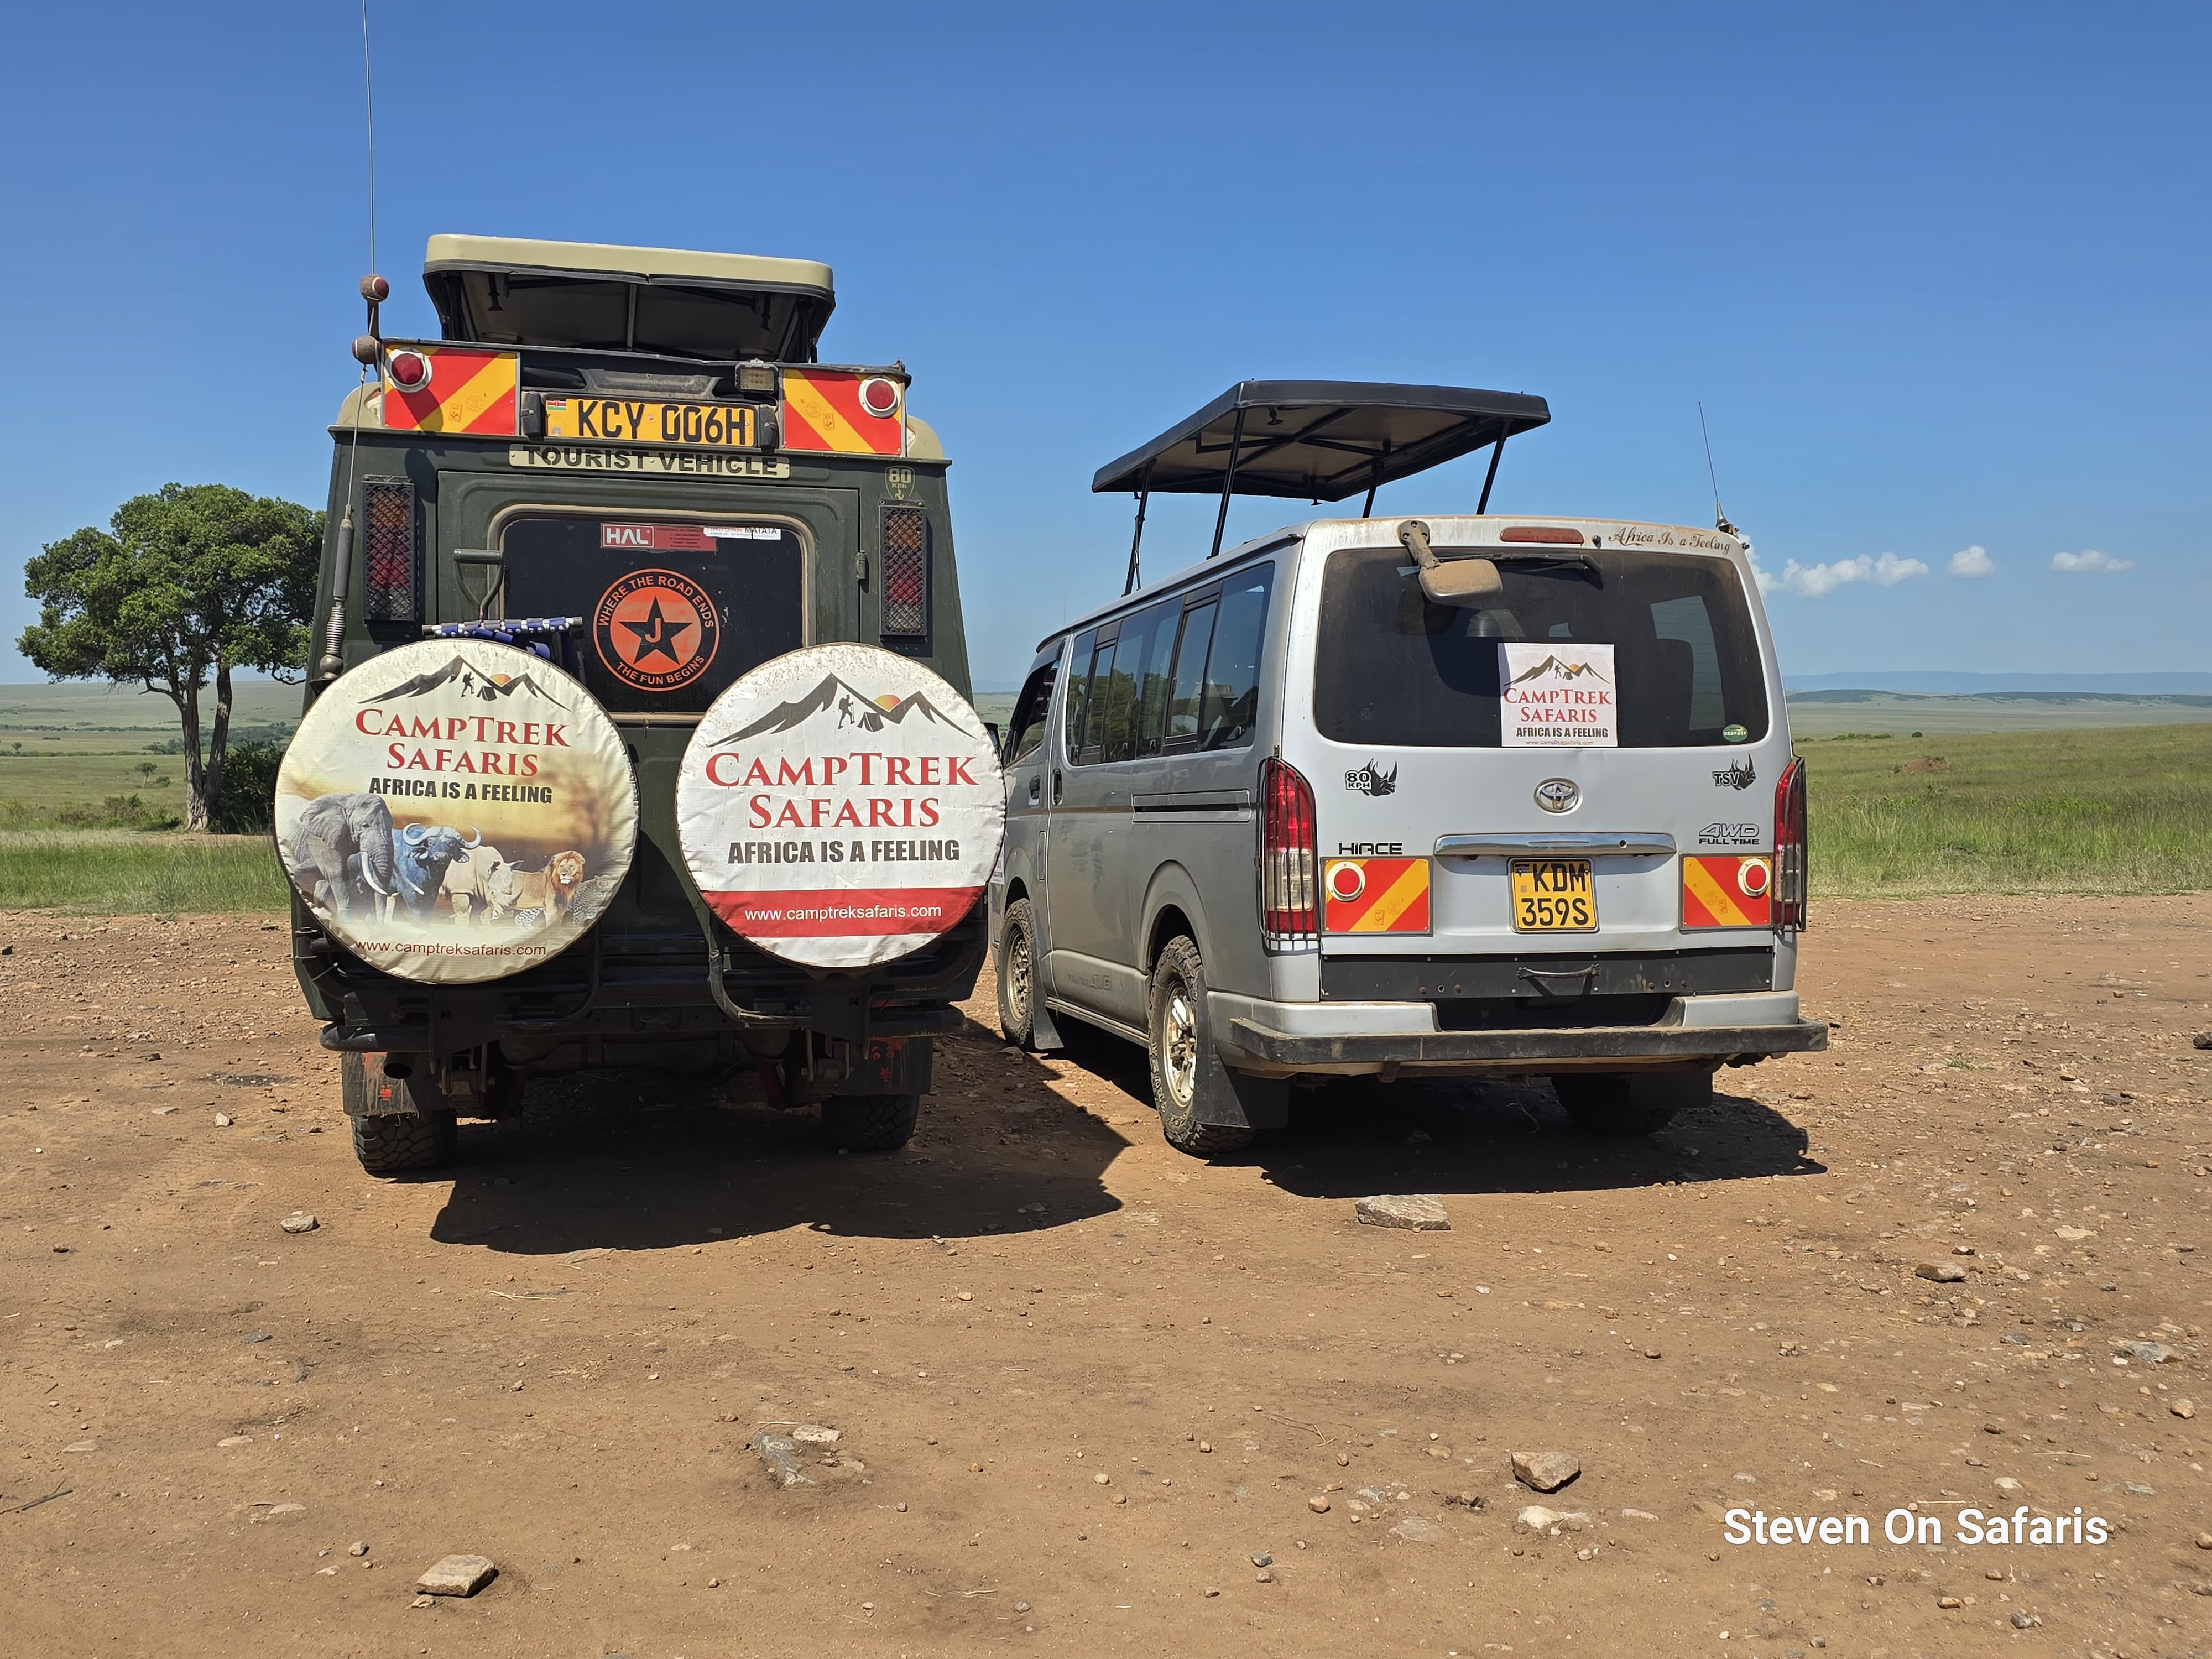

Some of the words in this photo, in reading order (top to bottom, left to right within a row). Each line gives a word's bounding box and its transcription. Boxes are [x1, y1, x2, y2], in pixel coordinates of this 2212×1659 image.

[578, 400, 644, 439] KCY
[662, 405, 746, 445] 006H
[524, 446, 649, 469] TOURIST
[659, 452, 778, 475] VEHICLE
[889, 468, 912, 483] 80
[606, 528, 649, 545] HAL
[1608, 526, 1655, 546] Africa
[1658, 531, 1673, 545] Is
[1689, 533, 1731, 555] Feeling
[598, 585, 629, 627] WHERE
[628, 575, 655, 590] THE
[658, 575, 694, 597] ROAD
[692, 596, 714, 629] ENDS
[645, 618, 661, 643] J
[616, 661, 639, 681] THE
[639, 675, 664, 685] FUN
[666, 655, 705, 685] BEGINS
[1516, 727, 1549, 737] AFRICA
[1552, 727, 1562, 737] IS
[1564, 727, 1571, 737] A
[1573, 728, 1608, 738] FEELING
[368, 776, 437, 797] AFRICA
[442, 780, 460, 799] IS
[463, 782, 481, 799] A
[482, 783, 552, 803] FEELING
[1347, 772, 1370, 782] 80
[1713, 773, 1740, 785] TSV
[1698, 823, 1760, 838] 4WD
[728, 841, 815, 864] AFRICA
[820, 840, 844, 862] IS
[849, 840, 866, 862] A
[872, 839, 959, 861] FEELING
[1338, 842, 1403, 855] HIACE
[1532, 863, 1586, 892] KDM
[744, 905, 942, 922] www.camptreksafaris.com
[1521, 898, 1589, 926] 359S
[355, 940, 546, 957] www.camptreksafaris.com
